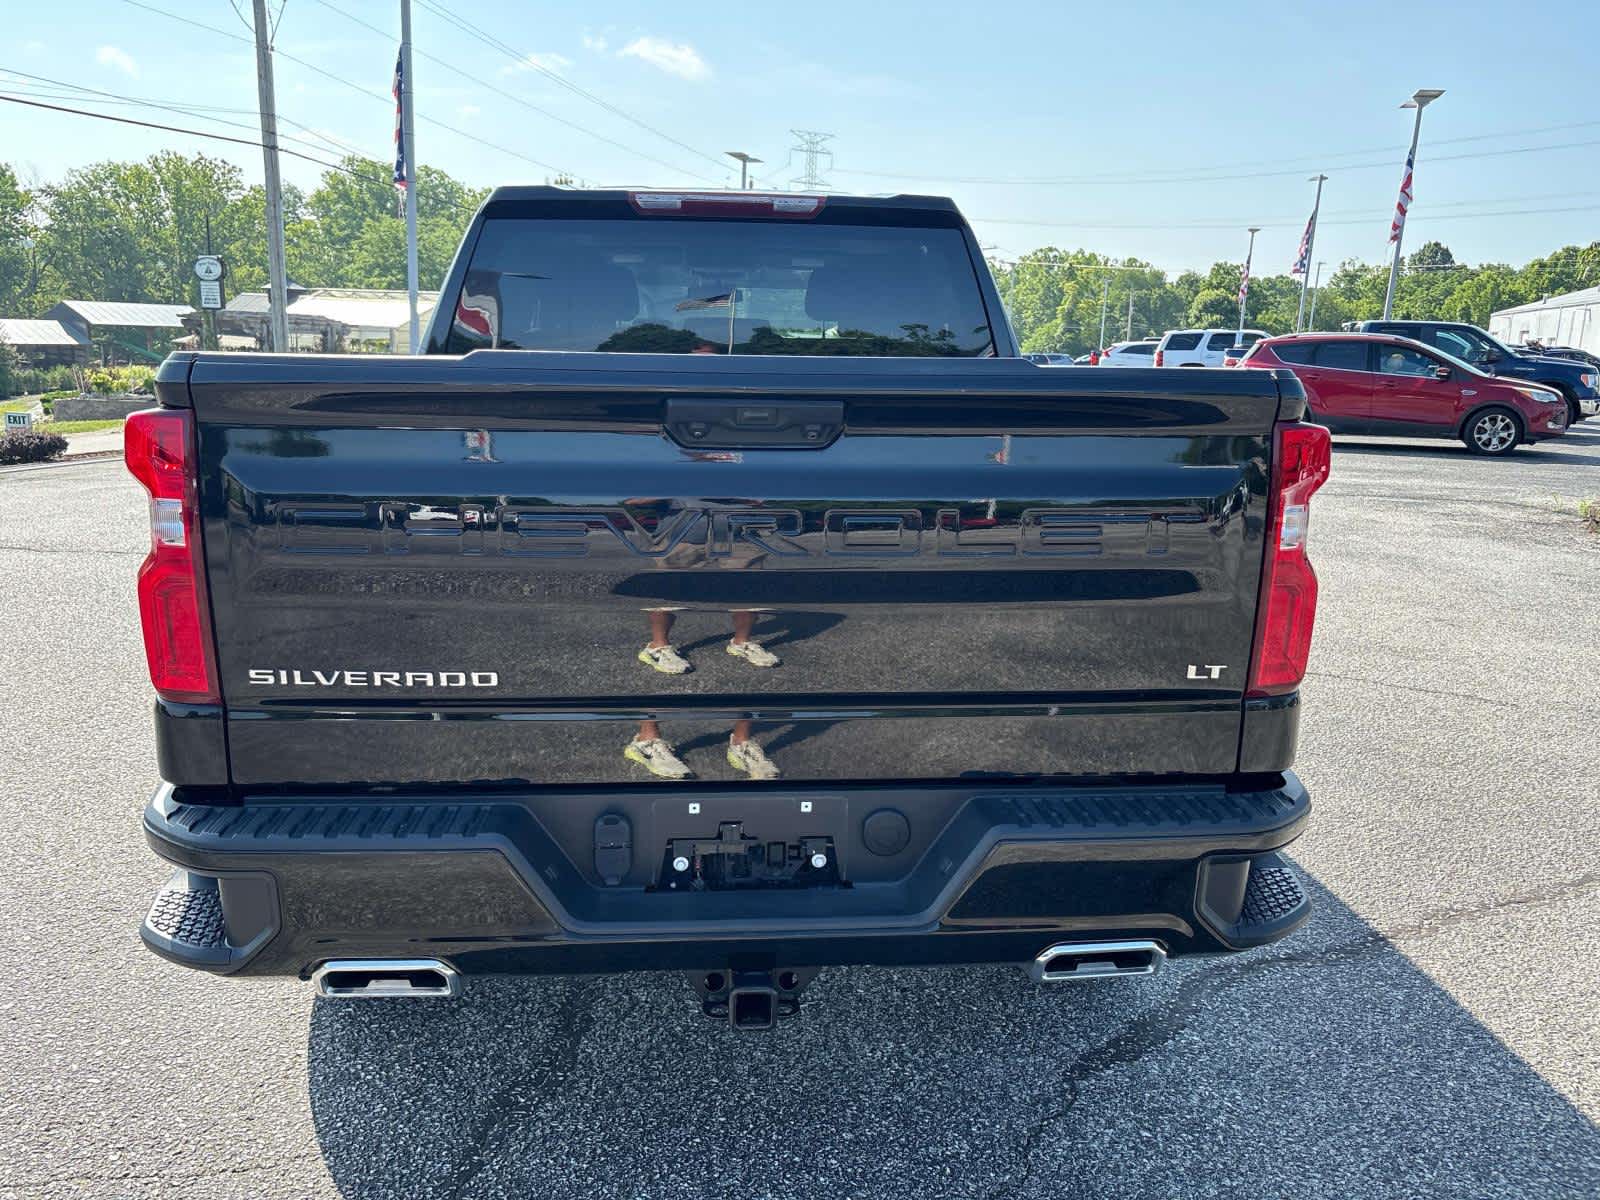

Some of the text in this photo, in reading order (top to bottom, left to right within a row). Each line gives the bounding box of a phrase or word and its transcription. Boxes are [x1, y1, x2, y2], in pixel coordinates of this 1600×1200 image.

[8, 415, 26, 424] EXIT
[276, 502, 1207, 556] CHEVROLET
[248, 669, 499, 688] SILVERADO
[1186, 664, 1227, 680] LT
